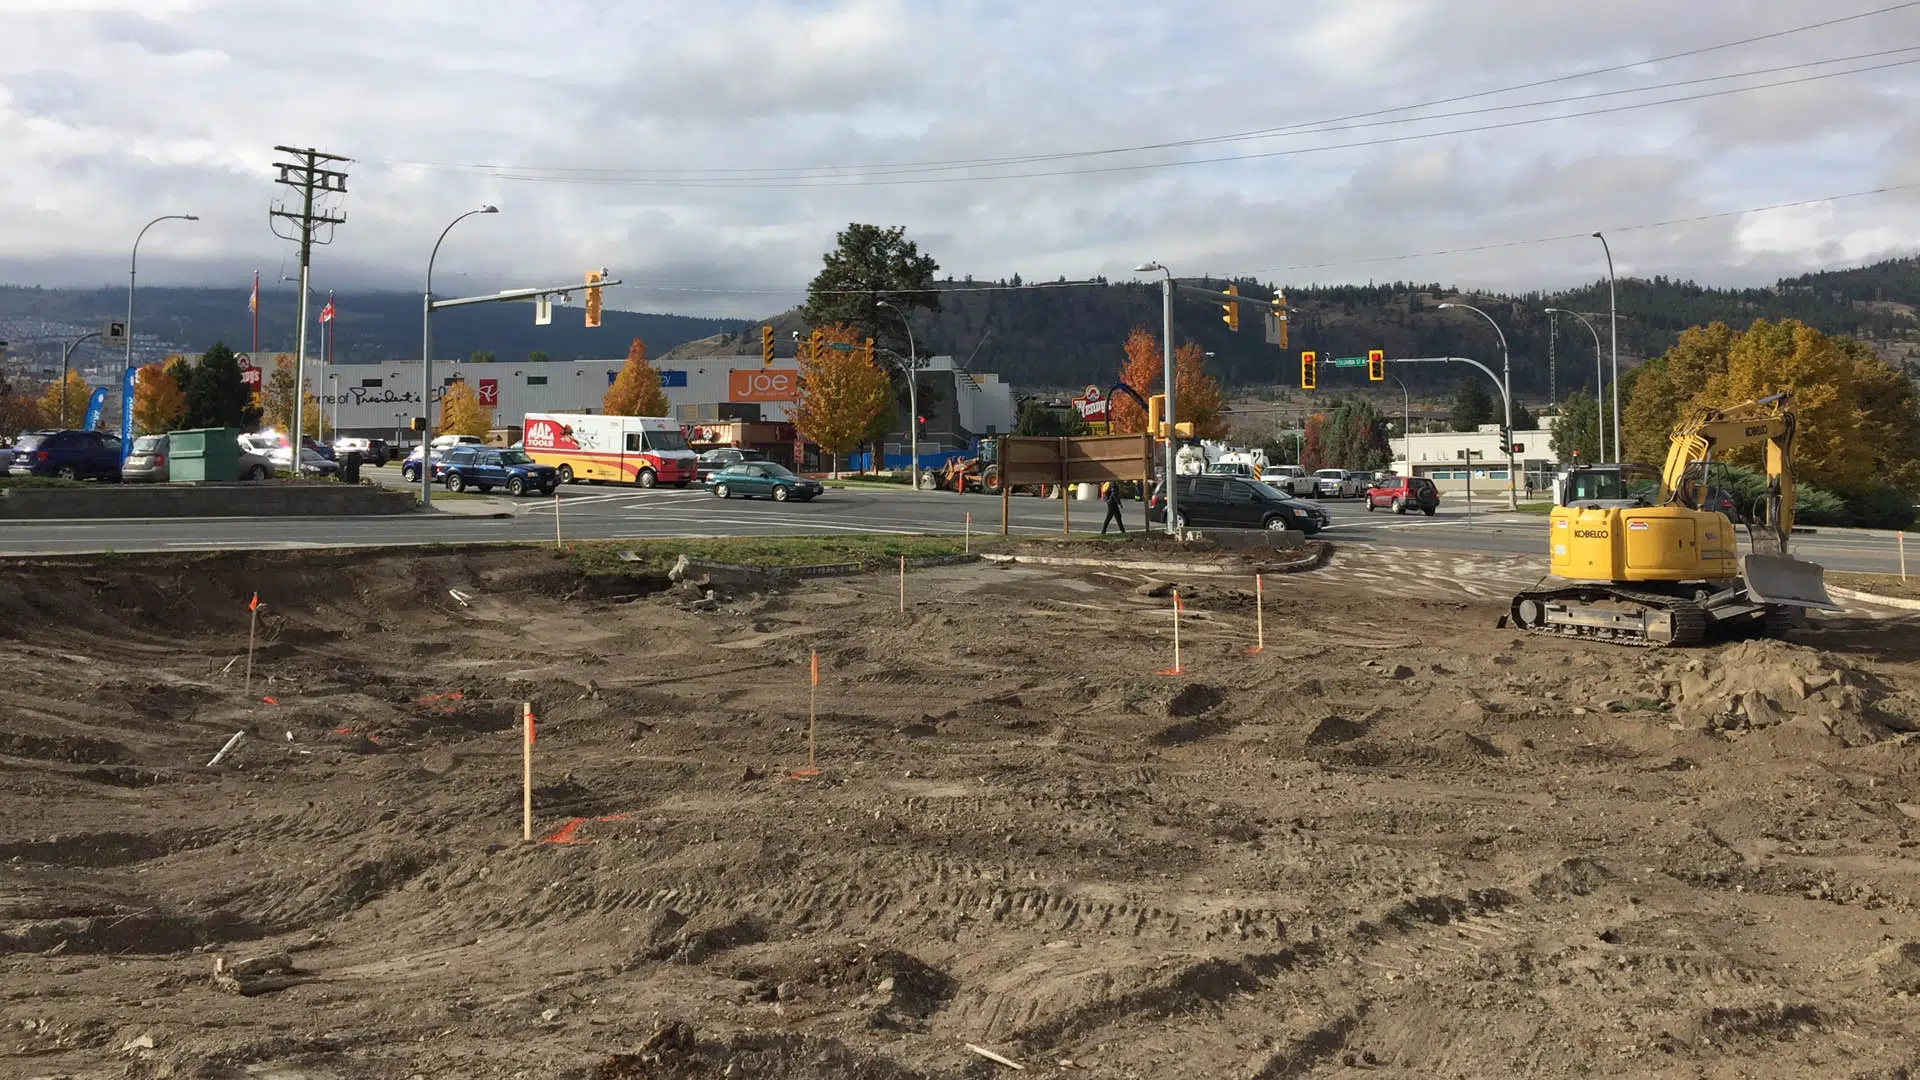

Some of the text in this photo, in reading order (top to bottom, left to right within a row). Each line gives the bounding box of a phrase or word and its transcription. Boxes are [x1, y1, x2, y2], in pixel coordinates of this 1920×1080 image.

[338, 392, 349, 405] of
[349, 387, 421, 406] President's
[1074, 399, 1112, 418] Wendys
[528, 422, 554, 440] MAC
[528, 439, 554, 447] TOOLS
[1574, 530, 1609, 539] KOBELCO
